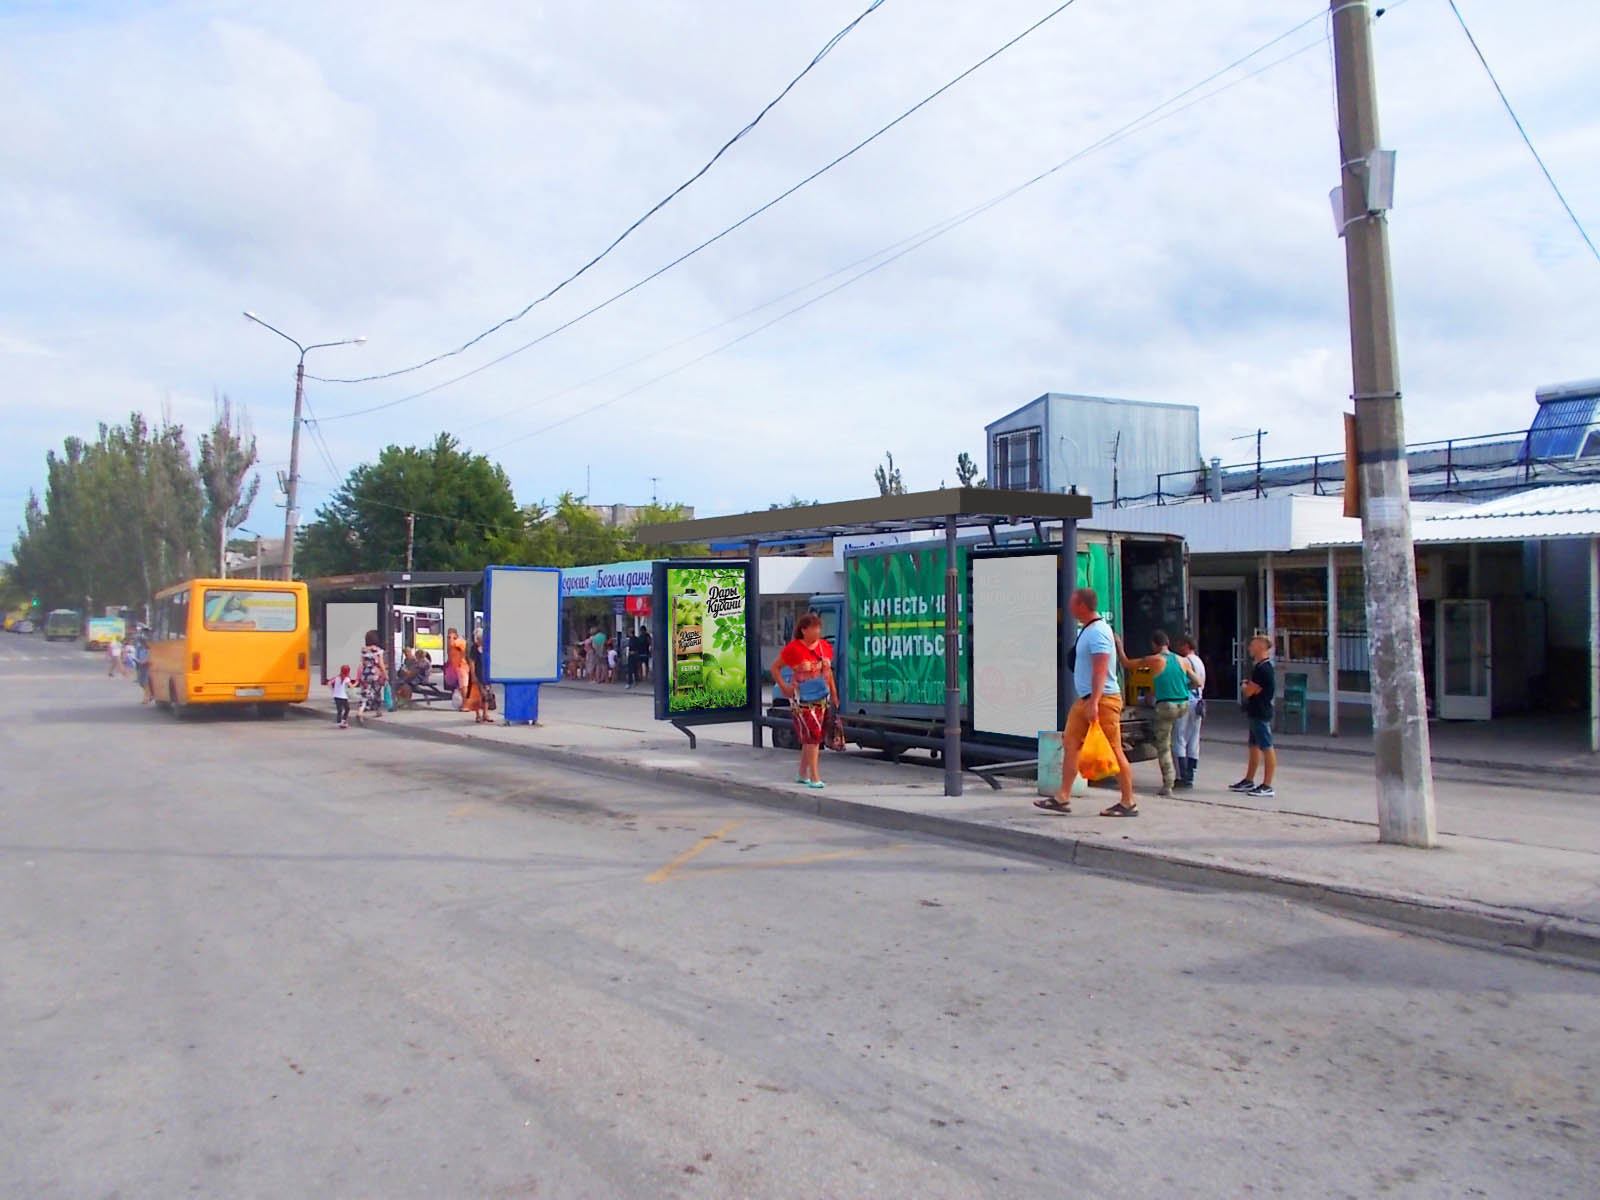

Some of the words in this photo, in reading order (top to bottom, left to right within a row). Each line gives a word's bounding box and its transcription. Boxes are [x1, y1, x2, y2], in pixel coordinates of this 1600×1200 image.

[708, 586, 739, 600] Дары
[706, 599, 741, 619] Кубани
[863, 598, 890, 617] НАМ
[894, 595, 928, 615] ЕСТЬ
[864, 633, 963, 660] ГОРДИТЬС!
